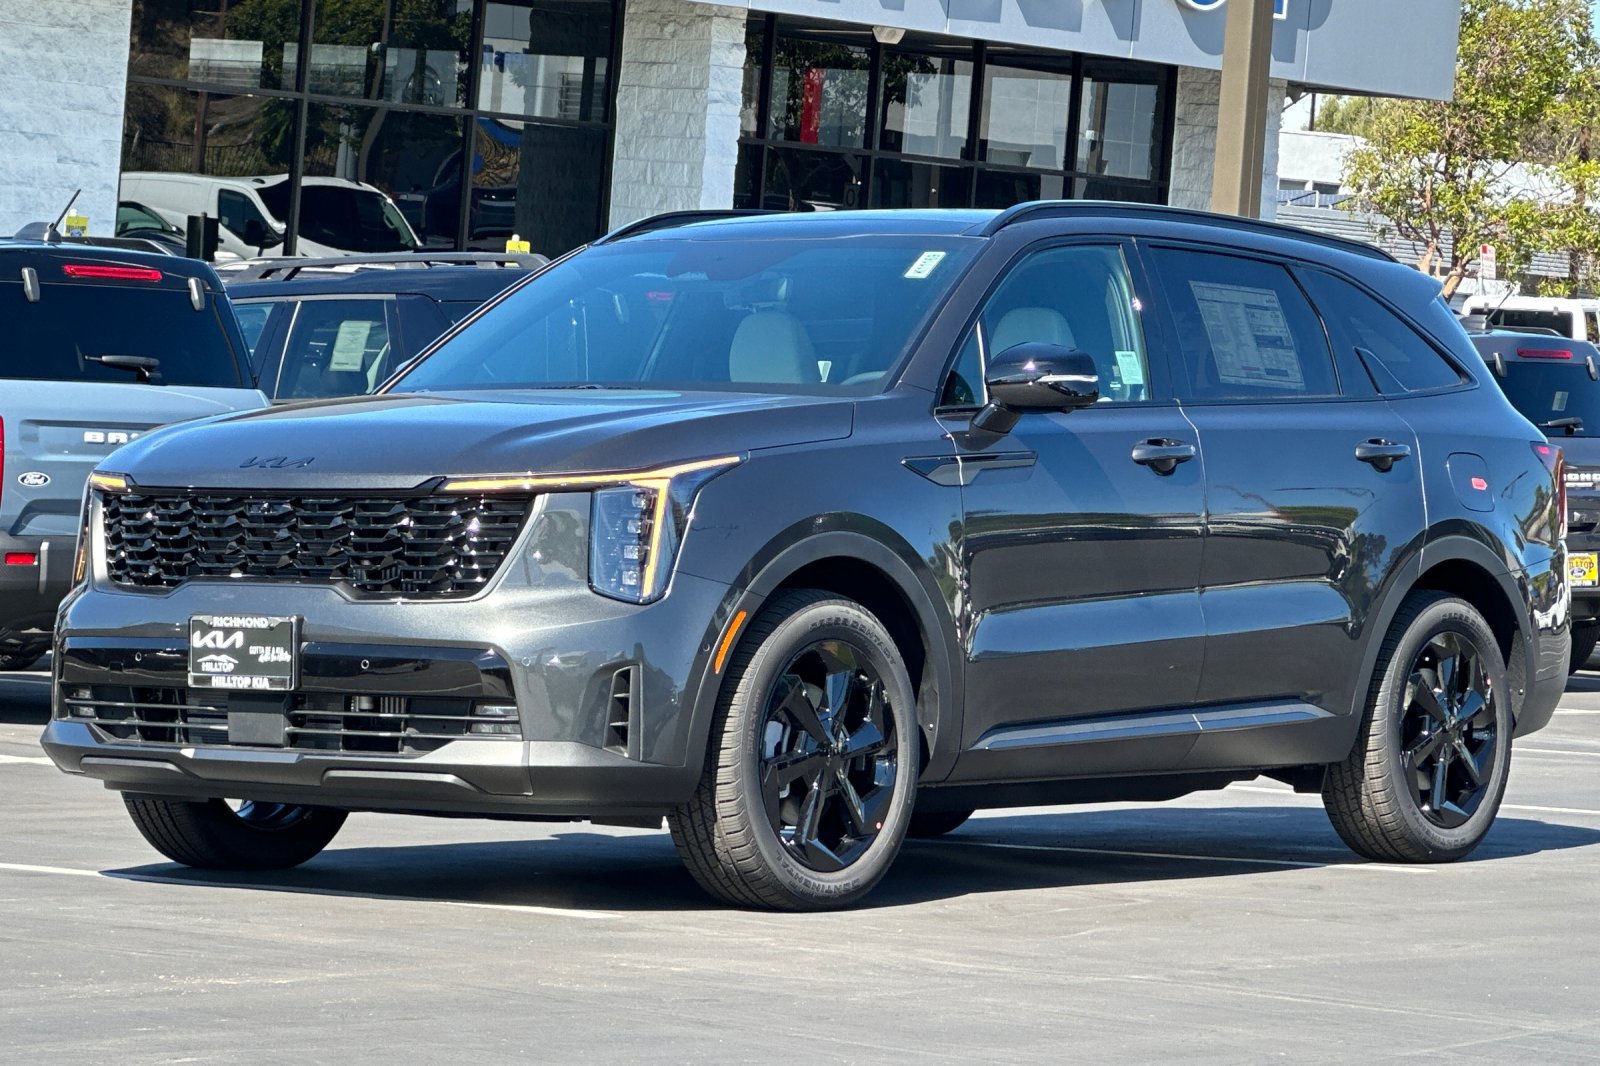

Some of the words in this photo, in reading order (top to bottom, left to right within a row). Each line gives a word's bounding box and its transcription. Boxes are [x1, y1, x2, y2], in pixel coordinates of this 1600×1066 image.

[213, 617, 269, 628] RICHMOND
[192, 631, 244, 649] KIA
[202, 662, 234, 672] HILLTOP
[212, 677, 251, 688] HILLTOP
[252, 678, 269, 689] KIA
